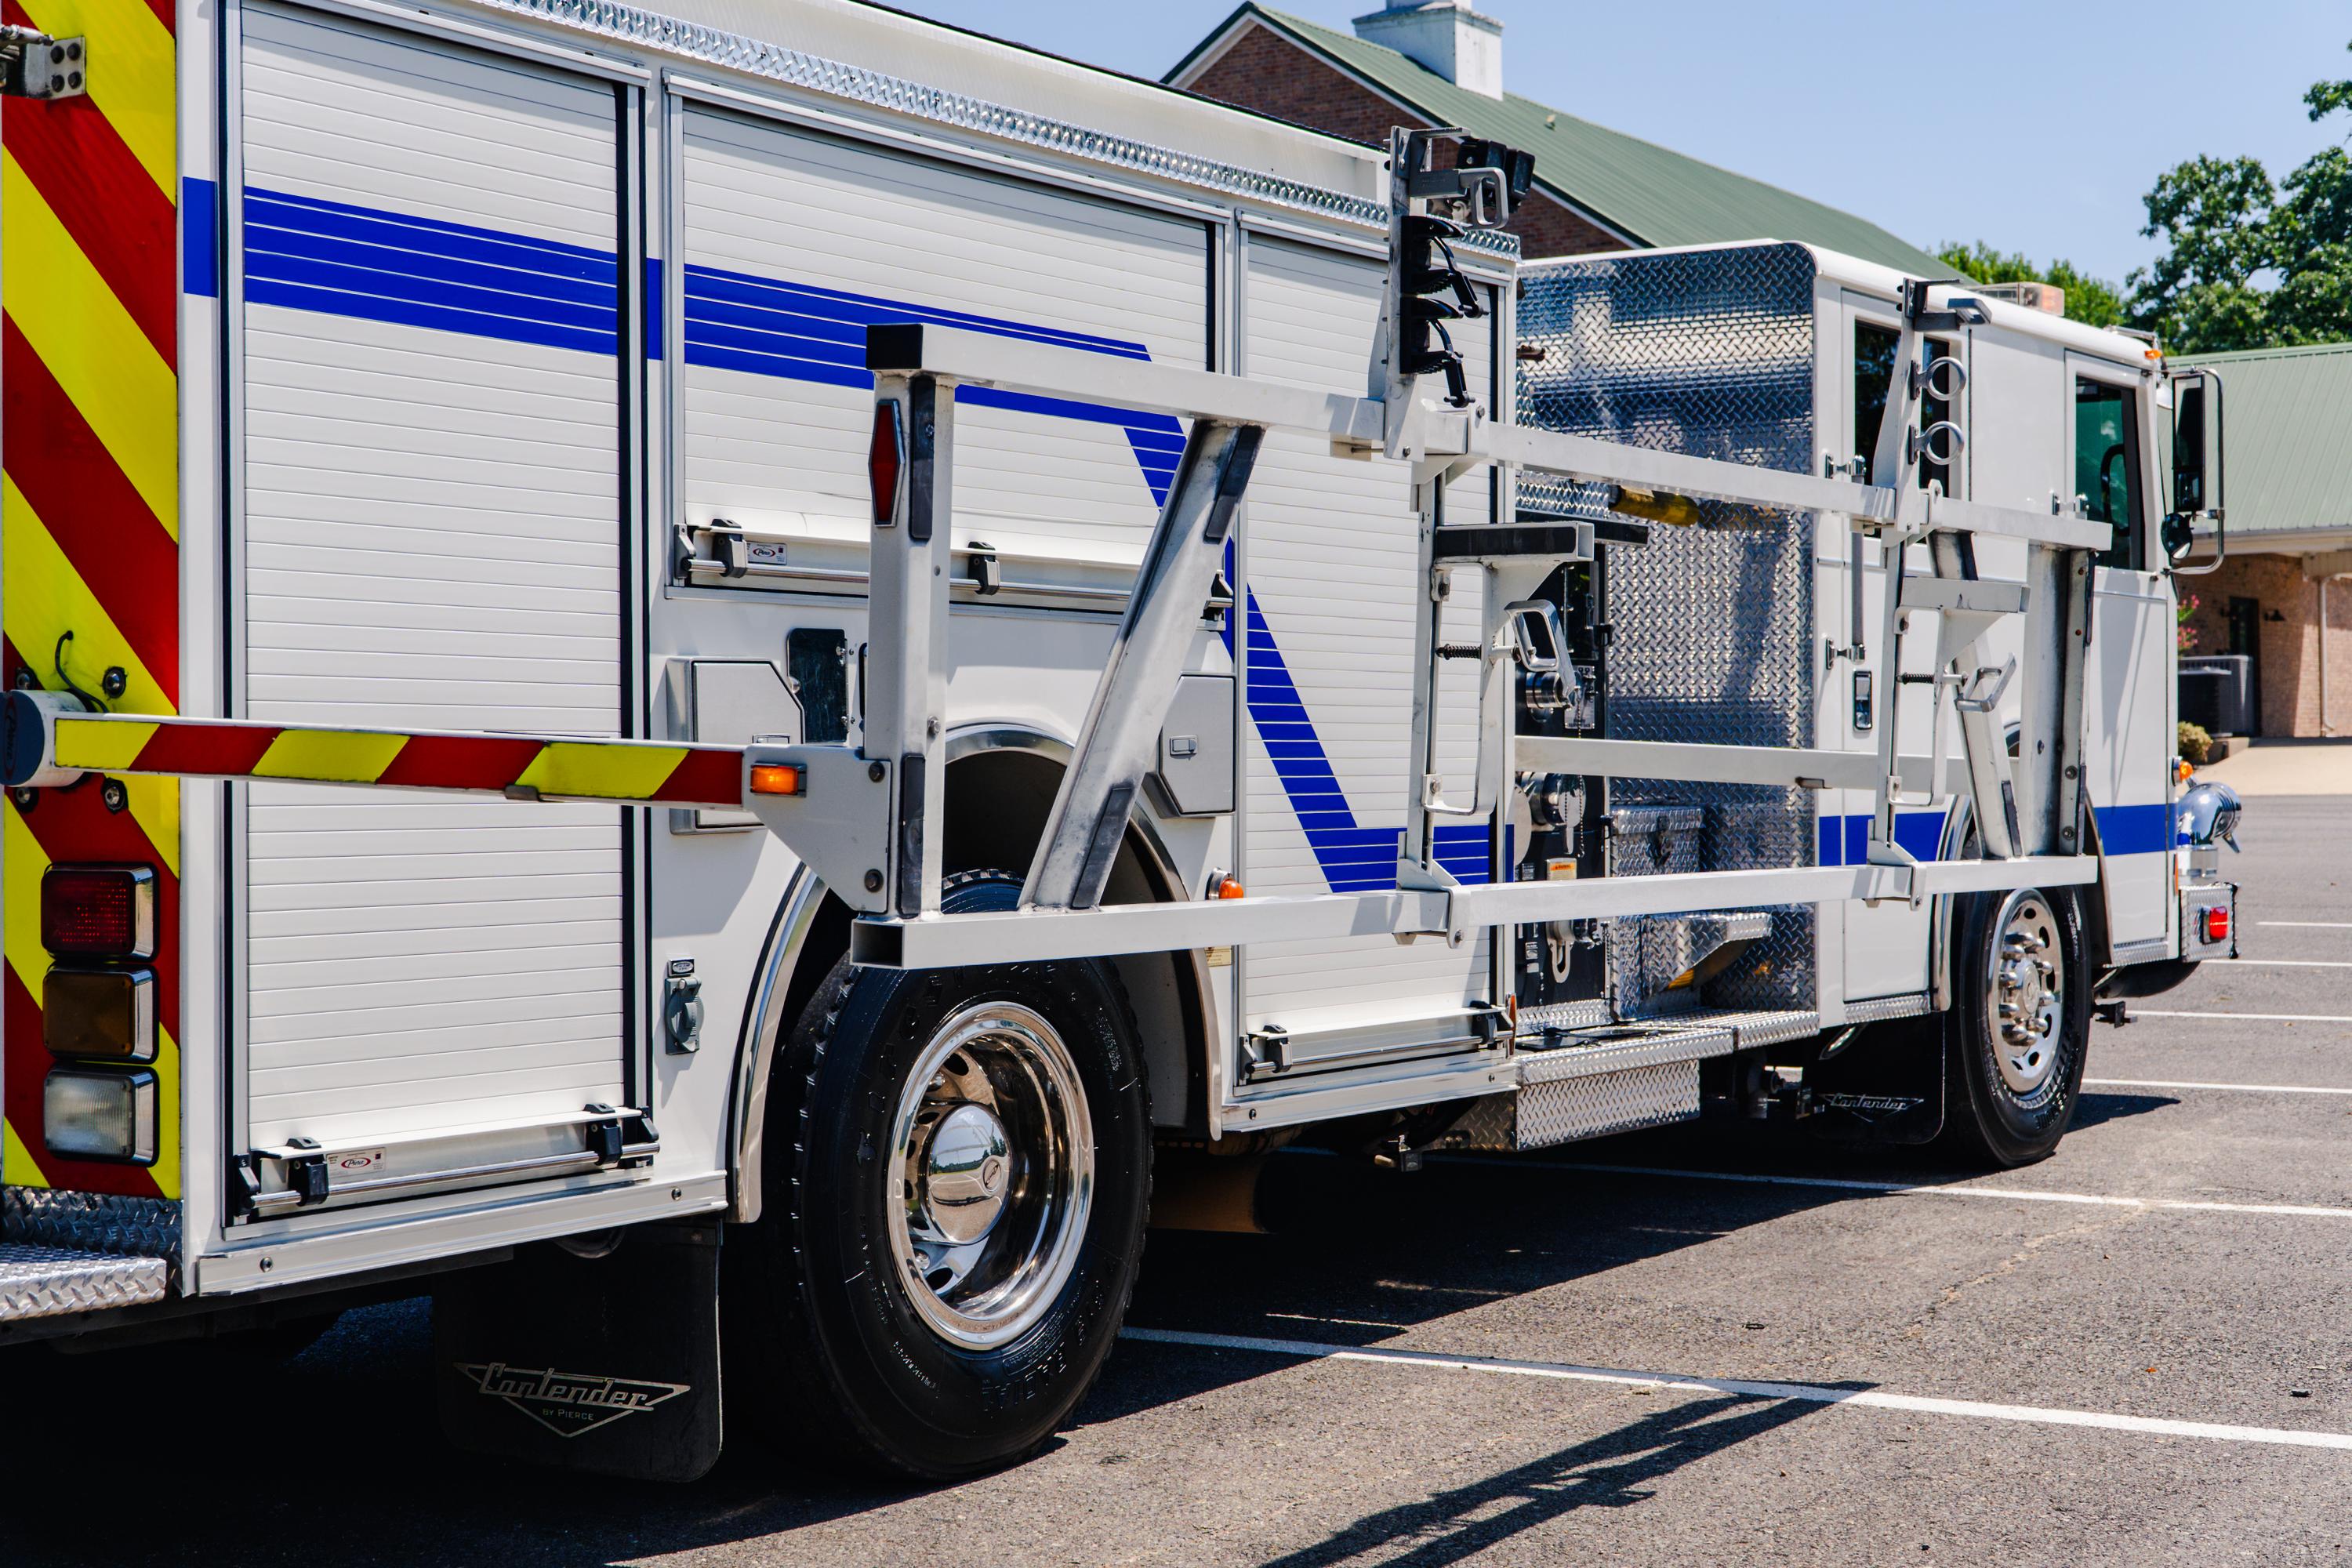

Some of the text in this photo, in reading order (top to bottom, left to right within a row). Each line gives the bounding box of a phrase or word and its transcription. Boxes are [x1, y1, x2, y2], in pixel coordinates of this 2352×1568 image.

[1830, 1092, 1908, 1111] Contender
[478, 1361, 654, 1411] Contender
[542, 1407, 554, 1417] BY
